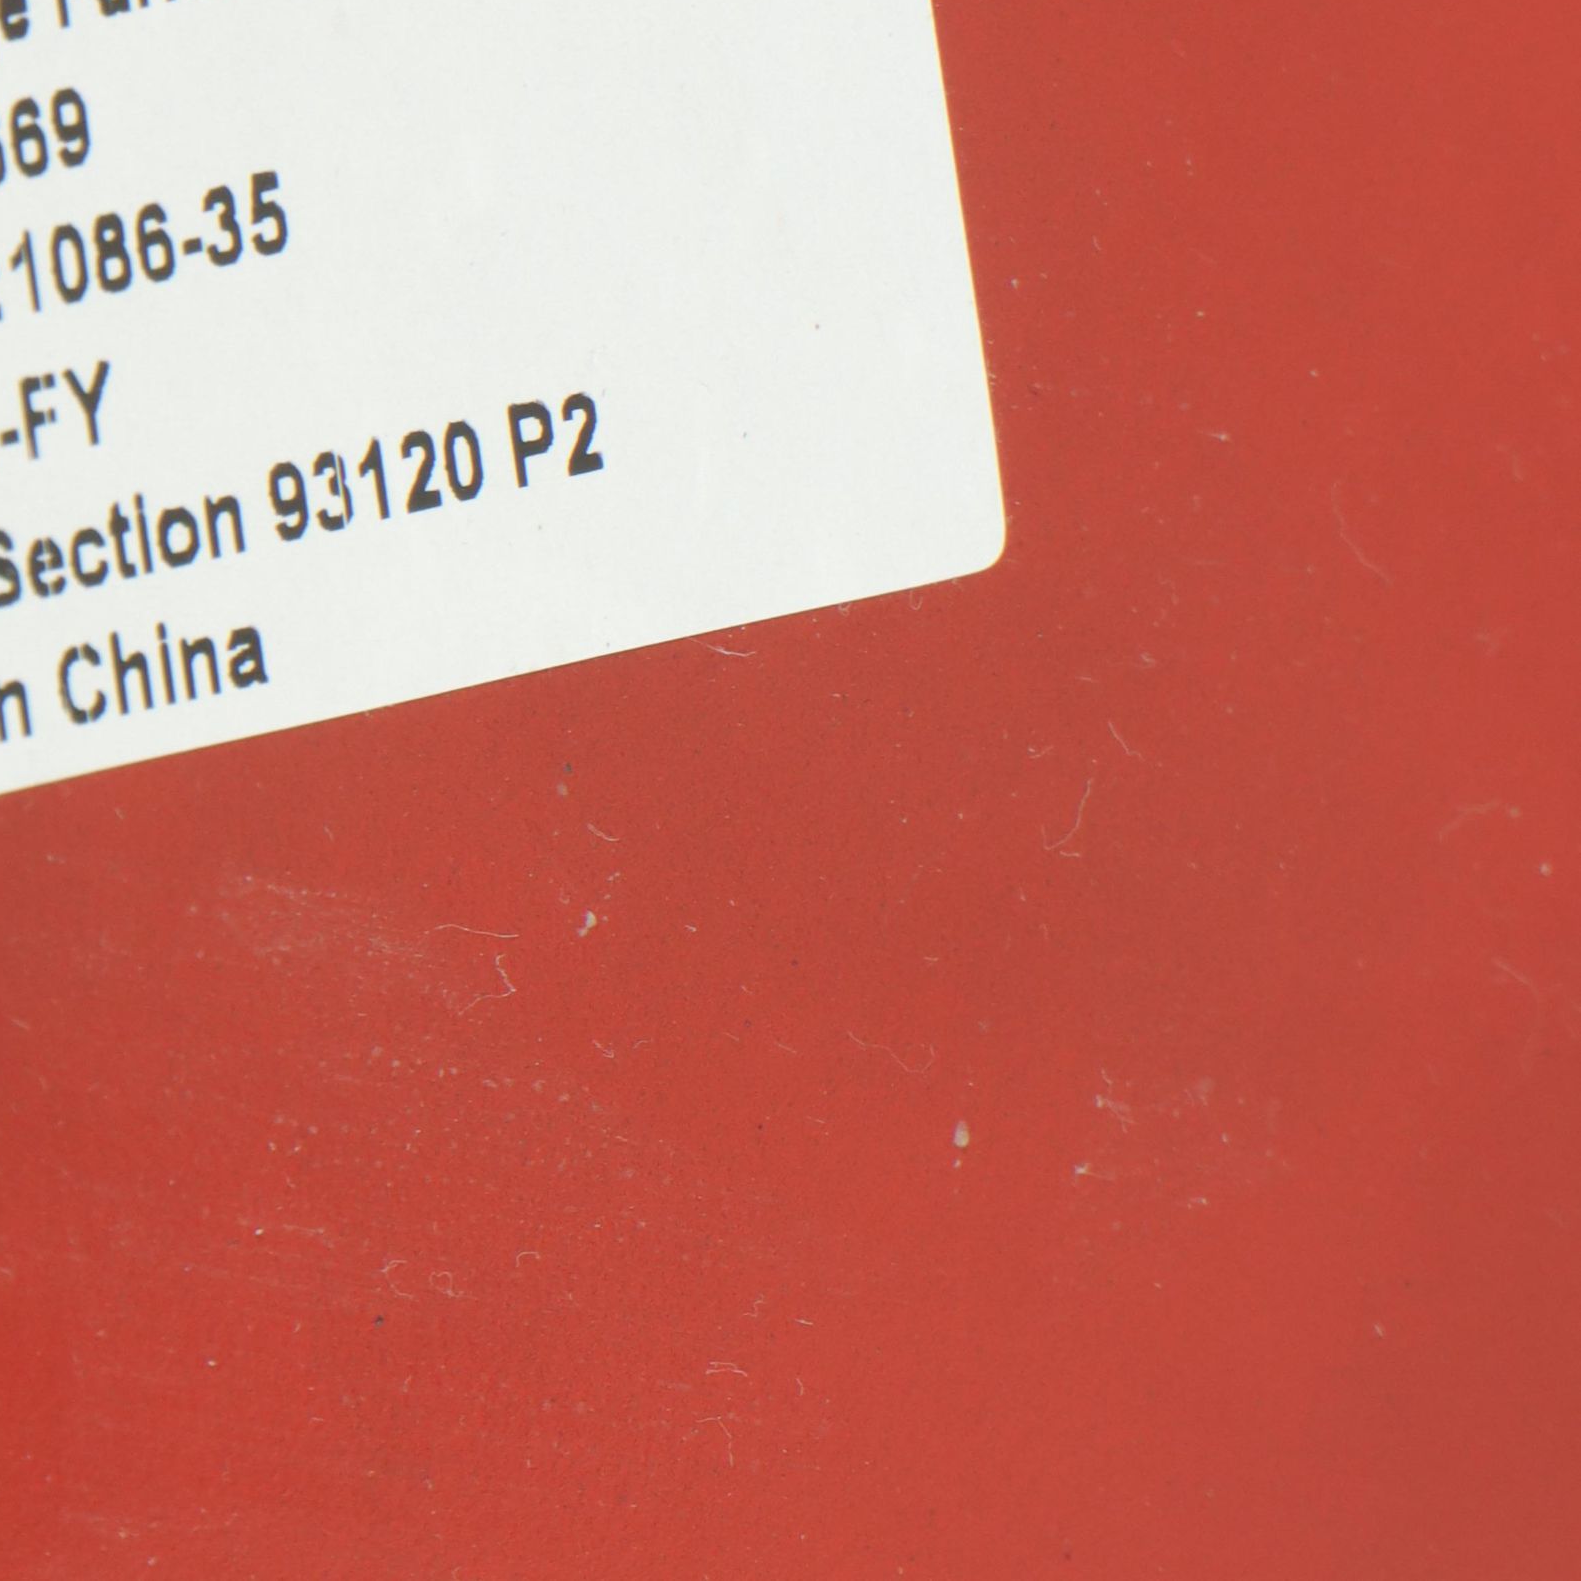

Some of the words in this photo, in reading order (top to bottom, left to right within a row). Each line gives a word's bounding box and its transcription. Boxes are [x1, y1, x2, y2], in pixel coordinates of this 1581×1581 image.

[270, 421, 483, 540] 93120
[509, 393, 603, 487] P2
[60, 624, 267, 723] China
